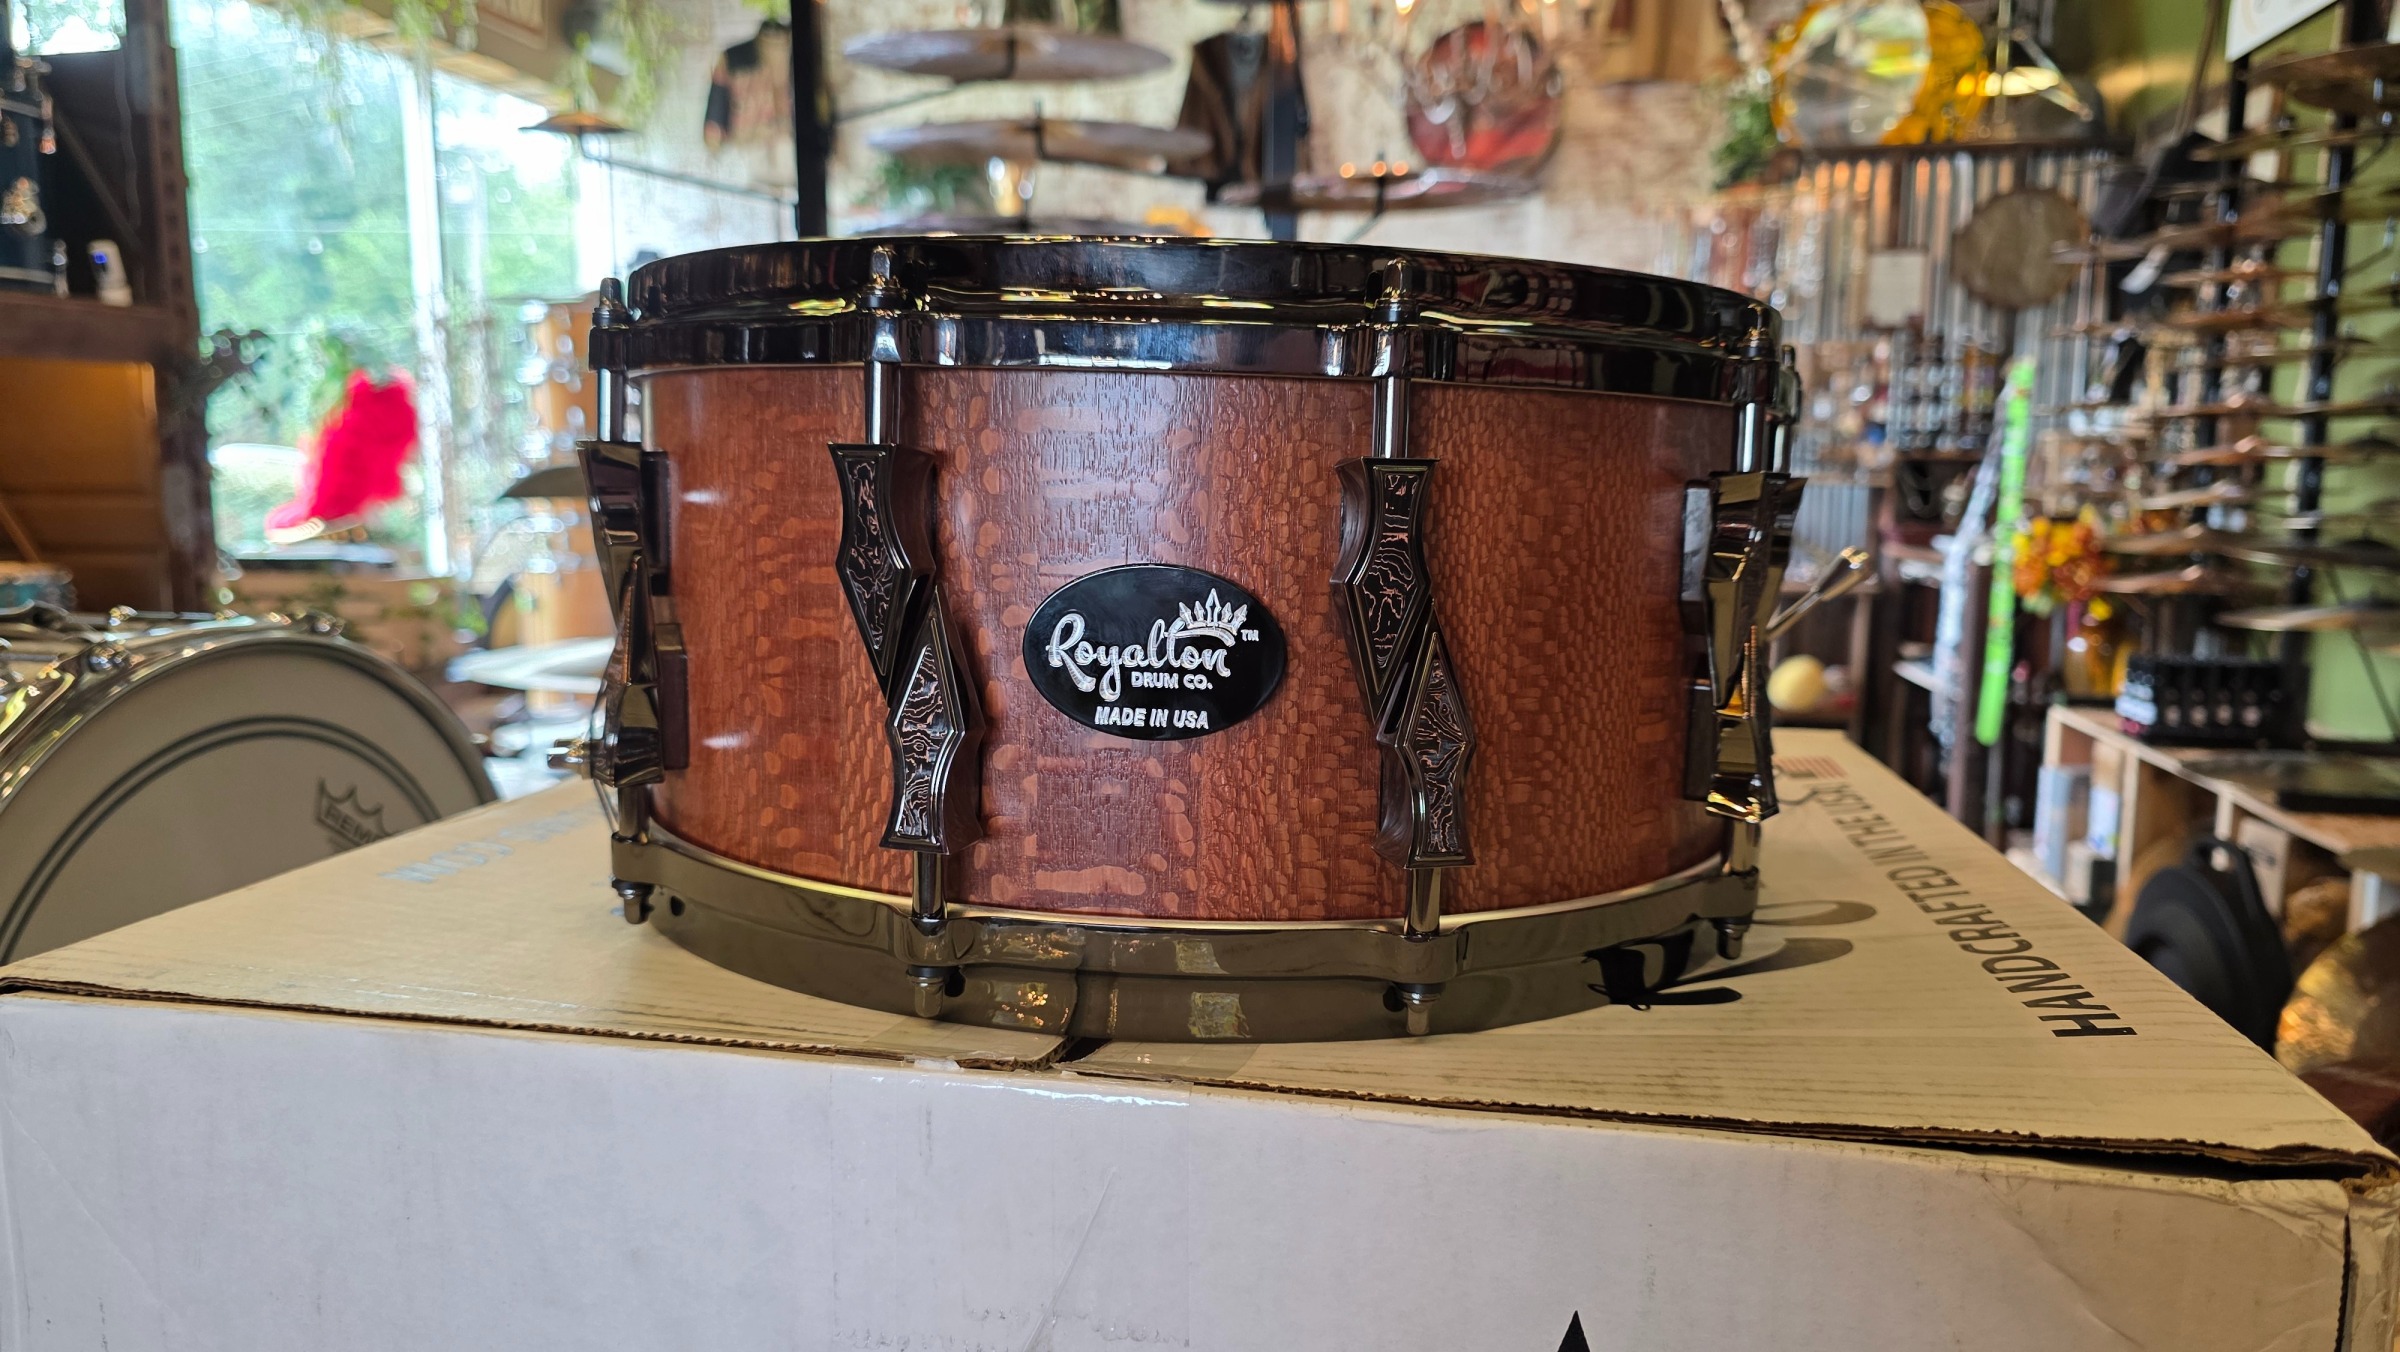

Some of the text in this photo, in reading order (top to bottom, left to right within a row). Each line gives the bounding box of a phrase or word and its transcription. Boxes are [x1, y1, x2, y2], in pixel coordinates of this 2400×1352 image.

[1046, 612, 1236, 702] Royalton
[1131, 671, 1213, 689] DRUM CO.
[1095, 706, 1209, 729] MADE IN USA
[324, 803, 380, 845] REM
[1832, 813, 1907, 848] THE
[1864, 844, 1930, 866] IN
[1886, 865, 2138, 1038] HANDCRAFTED
